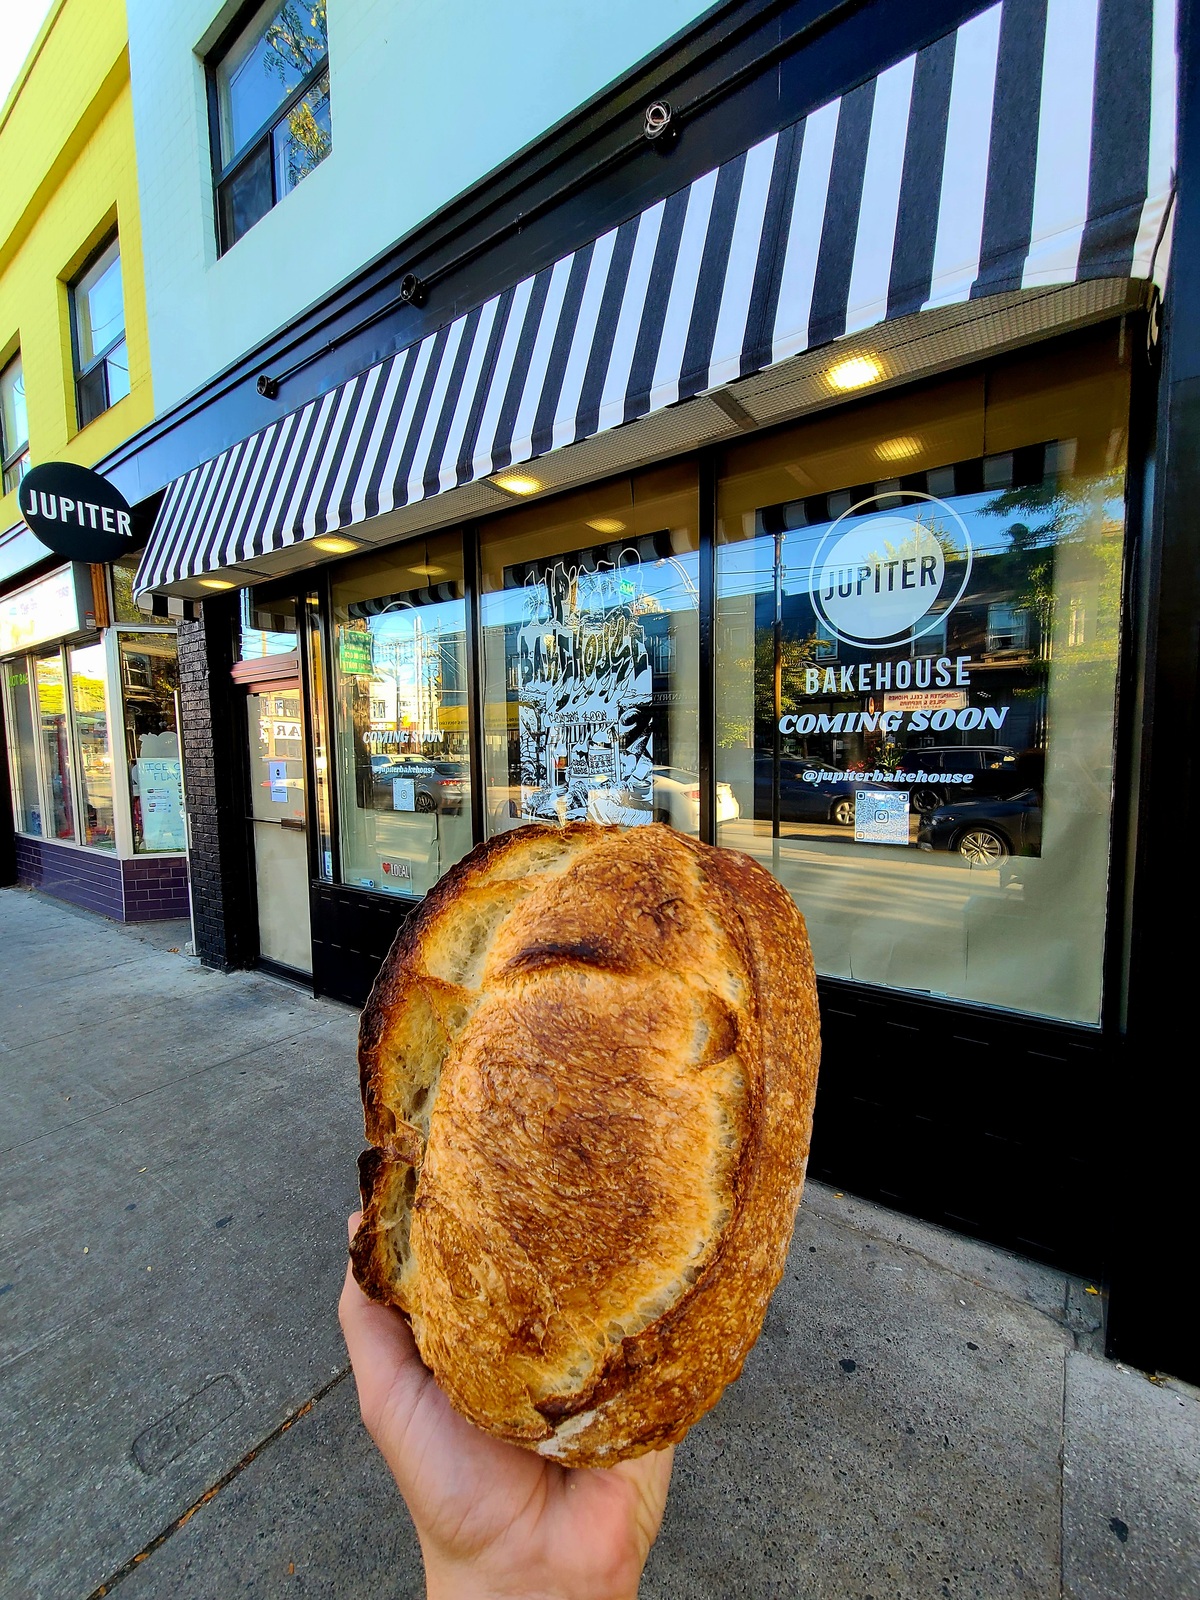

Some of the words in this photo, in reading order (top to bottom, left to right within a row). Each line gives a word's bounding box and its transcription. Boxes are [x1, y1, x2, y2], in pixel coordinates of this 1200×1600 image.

[26, 489, 134, 538] JUPITER
[824, 554, 938, 602] JUPITER
[805, 655, 972, 695] BAKEHOUSE
[778, 711, 904, 735] COMING
[907, 706, 1010, 732] SOON
[362, 730, 410, 744] COMING
[411, 729, 445, 743] SOON
[802, 768, 974, 785] @jupiterbakehouse
[390, 863, 410, 879] LOCAL
